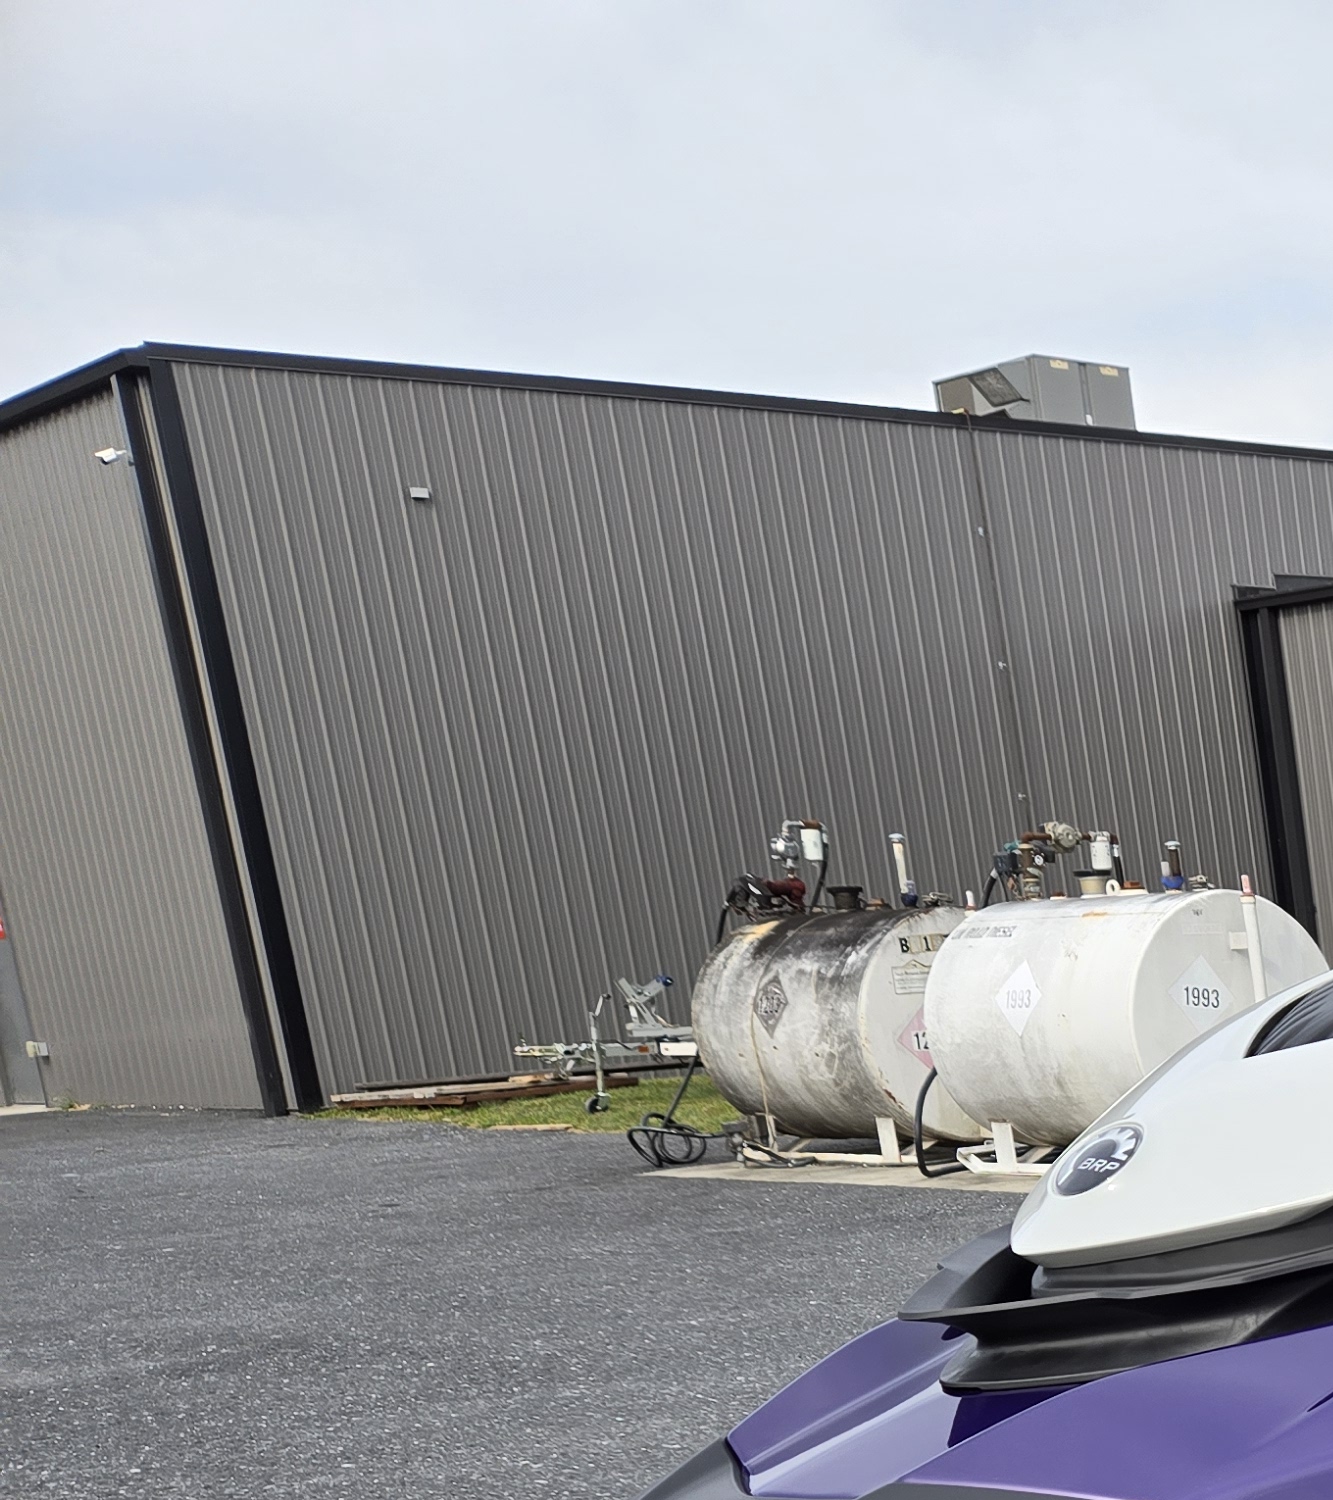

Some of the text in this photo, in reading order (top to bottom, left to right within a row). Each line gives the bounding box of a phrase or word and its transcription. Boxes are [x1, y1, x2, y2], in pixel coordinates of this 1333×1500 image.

[1006, 988, 1032, 1009] 1993
[1184, 985, 1220, 1009] 1993
[1077, 1157, 1121, 1173] BRP
